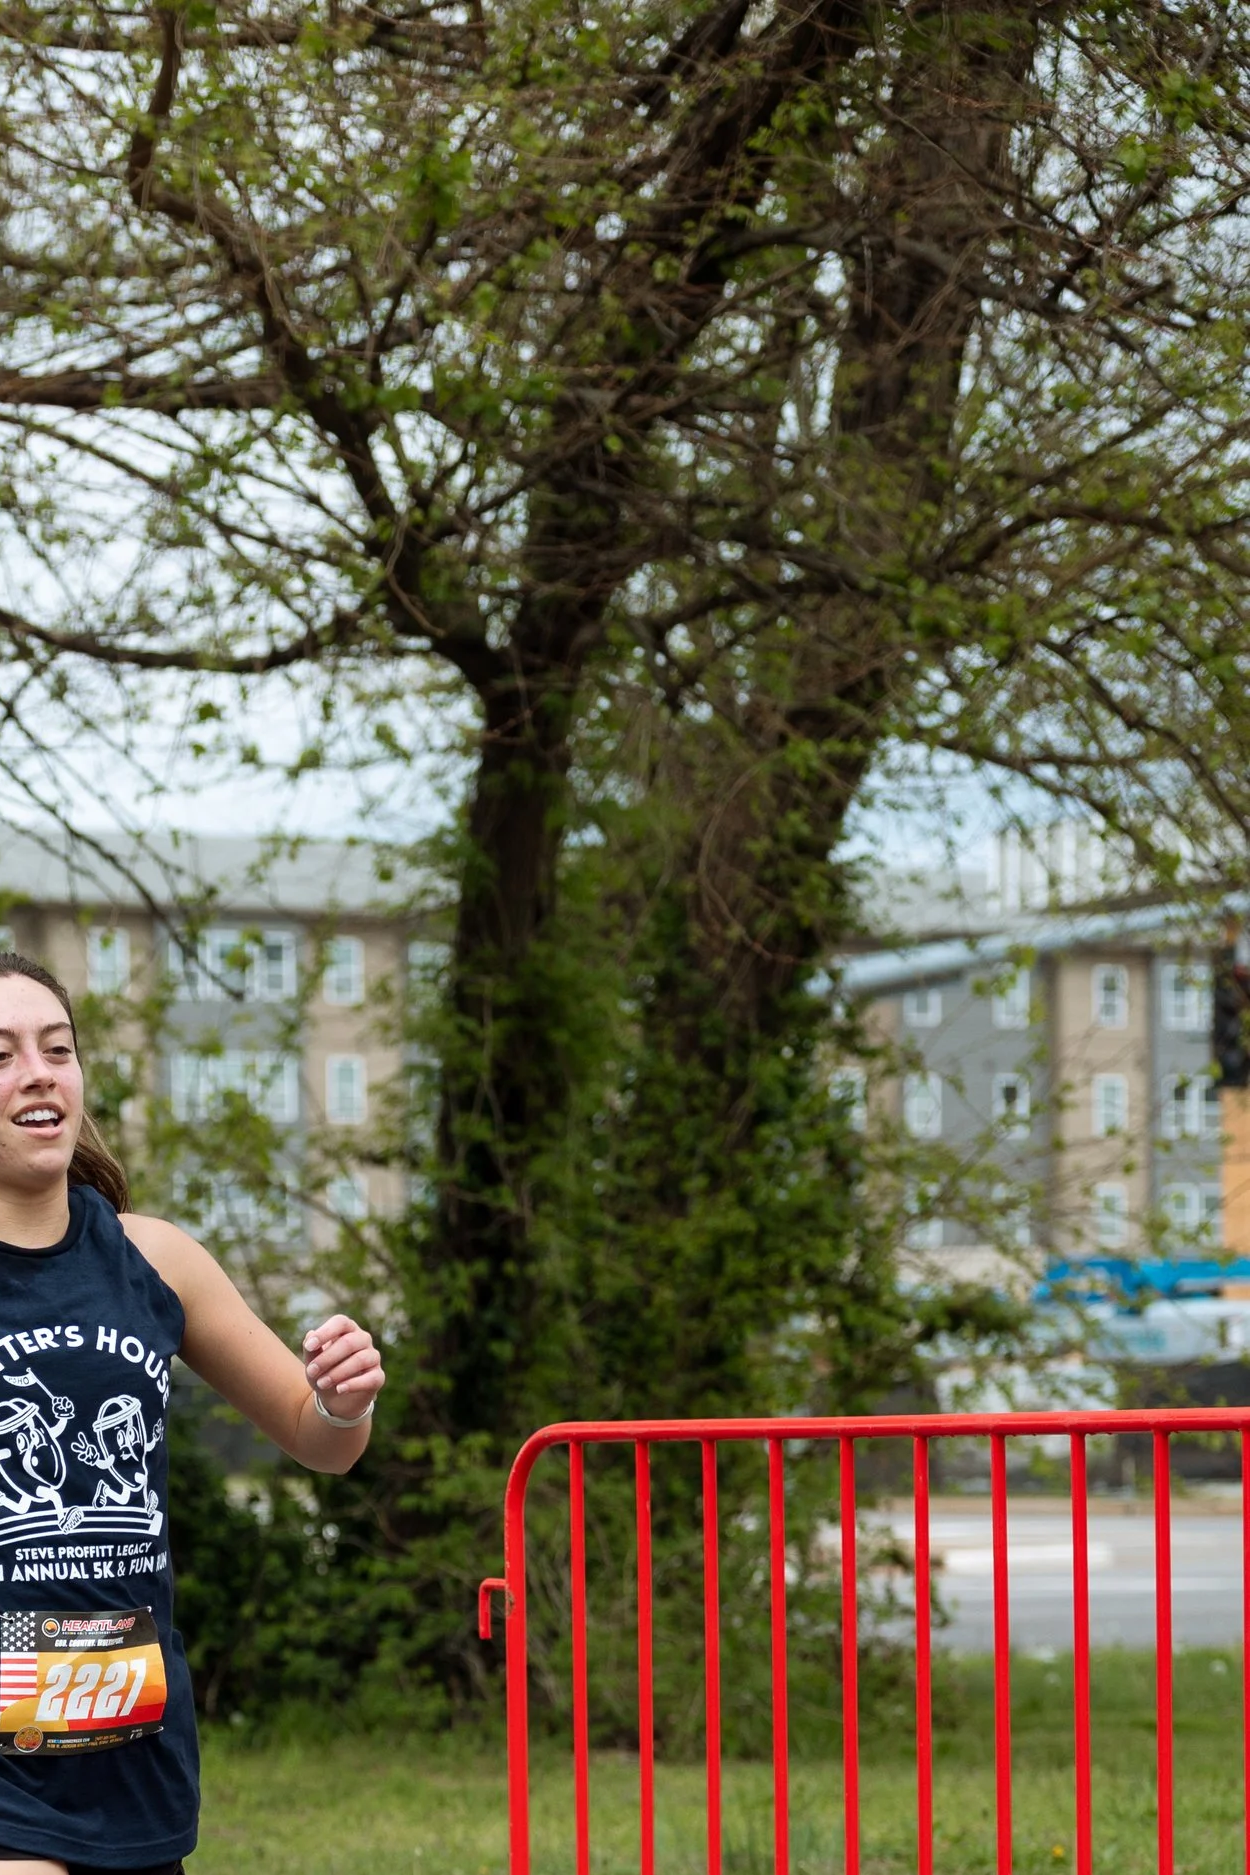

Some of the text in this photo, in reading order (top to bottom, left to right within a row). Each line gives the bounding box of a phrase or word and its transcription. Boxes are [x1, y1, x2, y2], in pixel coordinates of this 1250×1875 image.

[15, 1541, 152, 1561] STEVE PROFFITT LEGACY
[11, 1561, 89, 1582] ANNUAL
[93, 1560, 114, 1579] 5K
[116, 1560, 126, 1577] &
[129, 1555, 155, 1575] FUN
[61, 1616, 136, 1632] HEARTLAND
[35, 1658, 147, 1722] 2227
